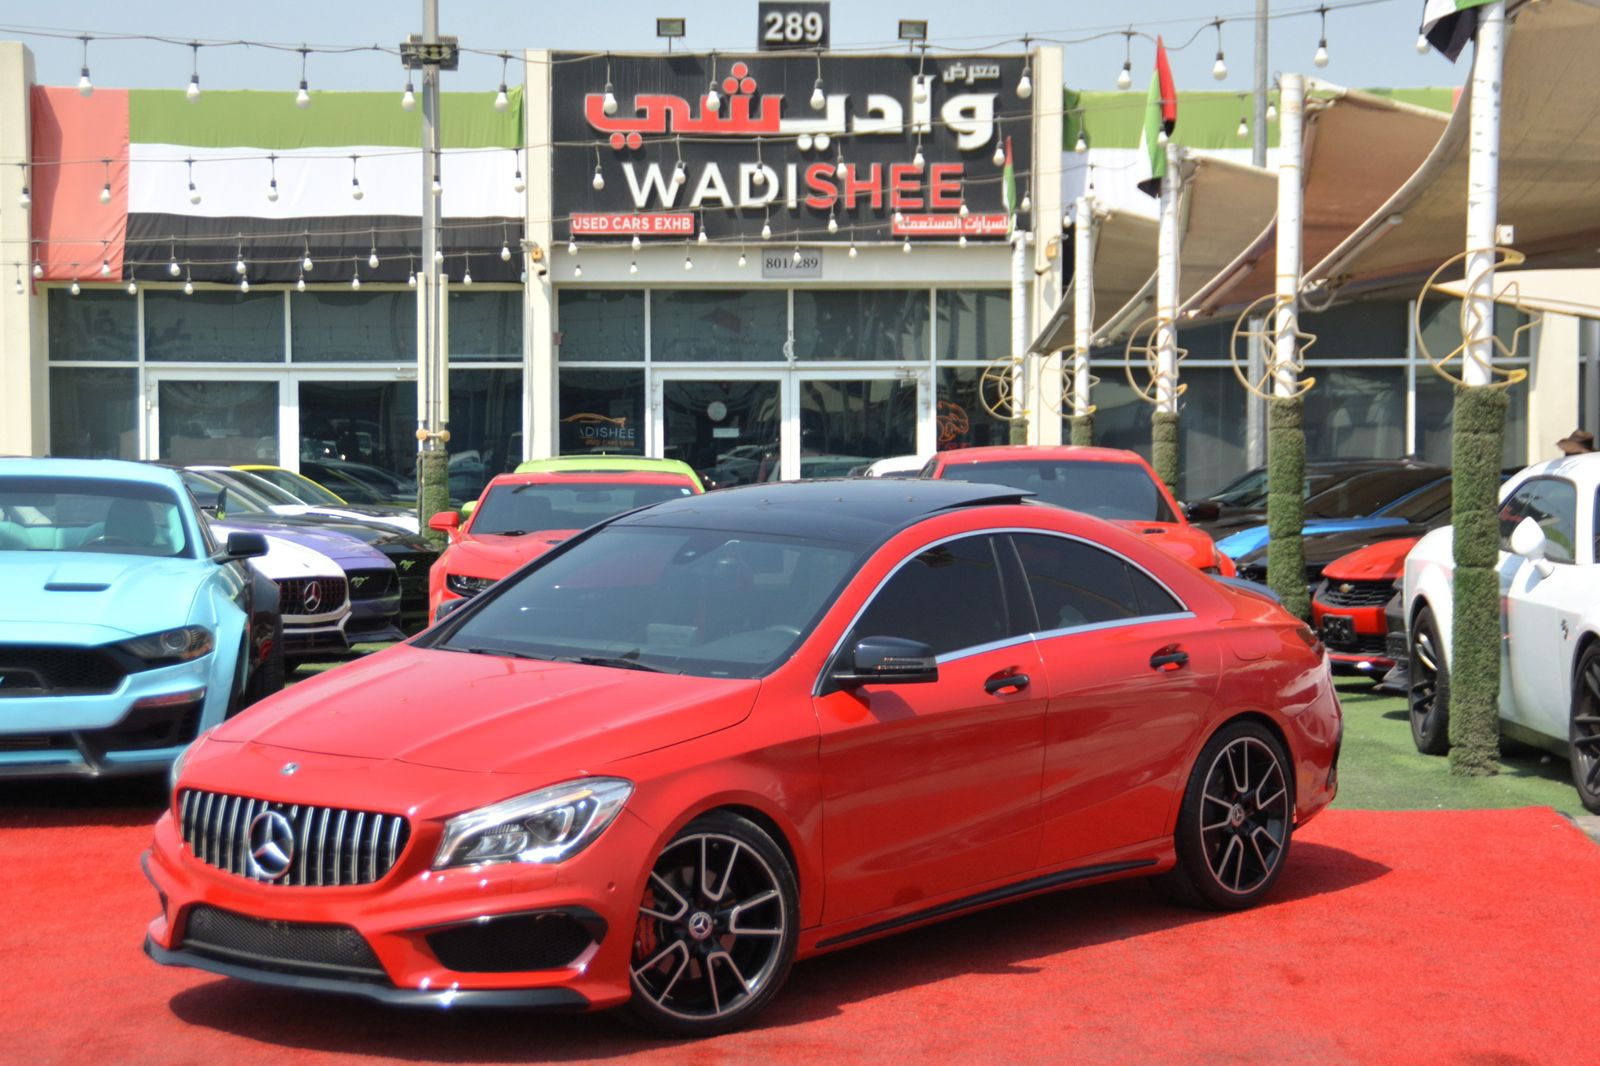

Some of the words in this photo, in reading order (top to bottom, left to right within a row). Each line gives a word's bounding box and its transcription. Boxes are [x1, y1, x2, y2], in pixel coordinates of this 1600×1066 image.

[764, 11, 823, 42] 289
[943, 62, 1000, 85] معرض
[622, 162, 965, 210] WADISHEE
[573, 217, 609, 230] USED
[612, 217, 650, 230] CARS
[654, 217, 691, 230] EXHB
